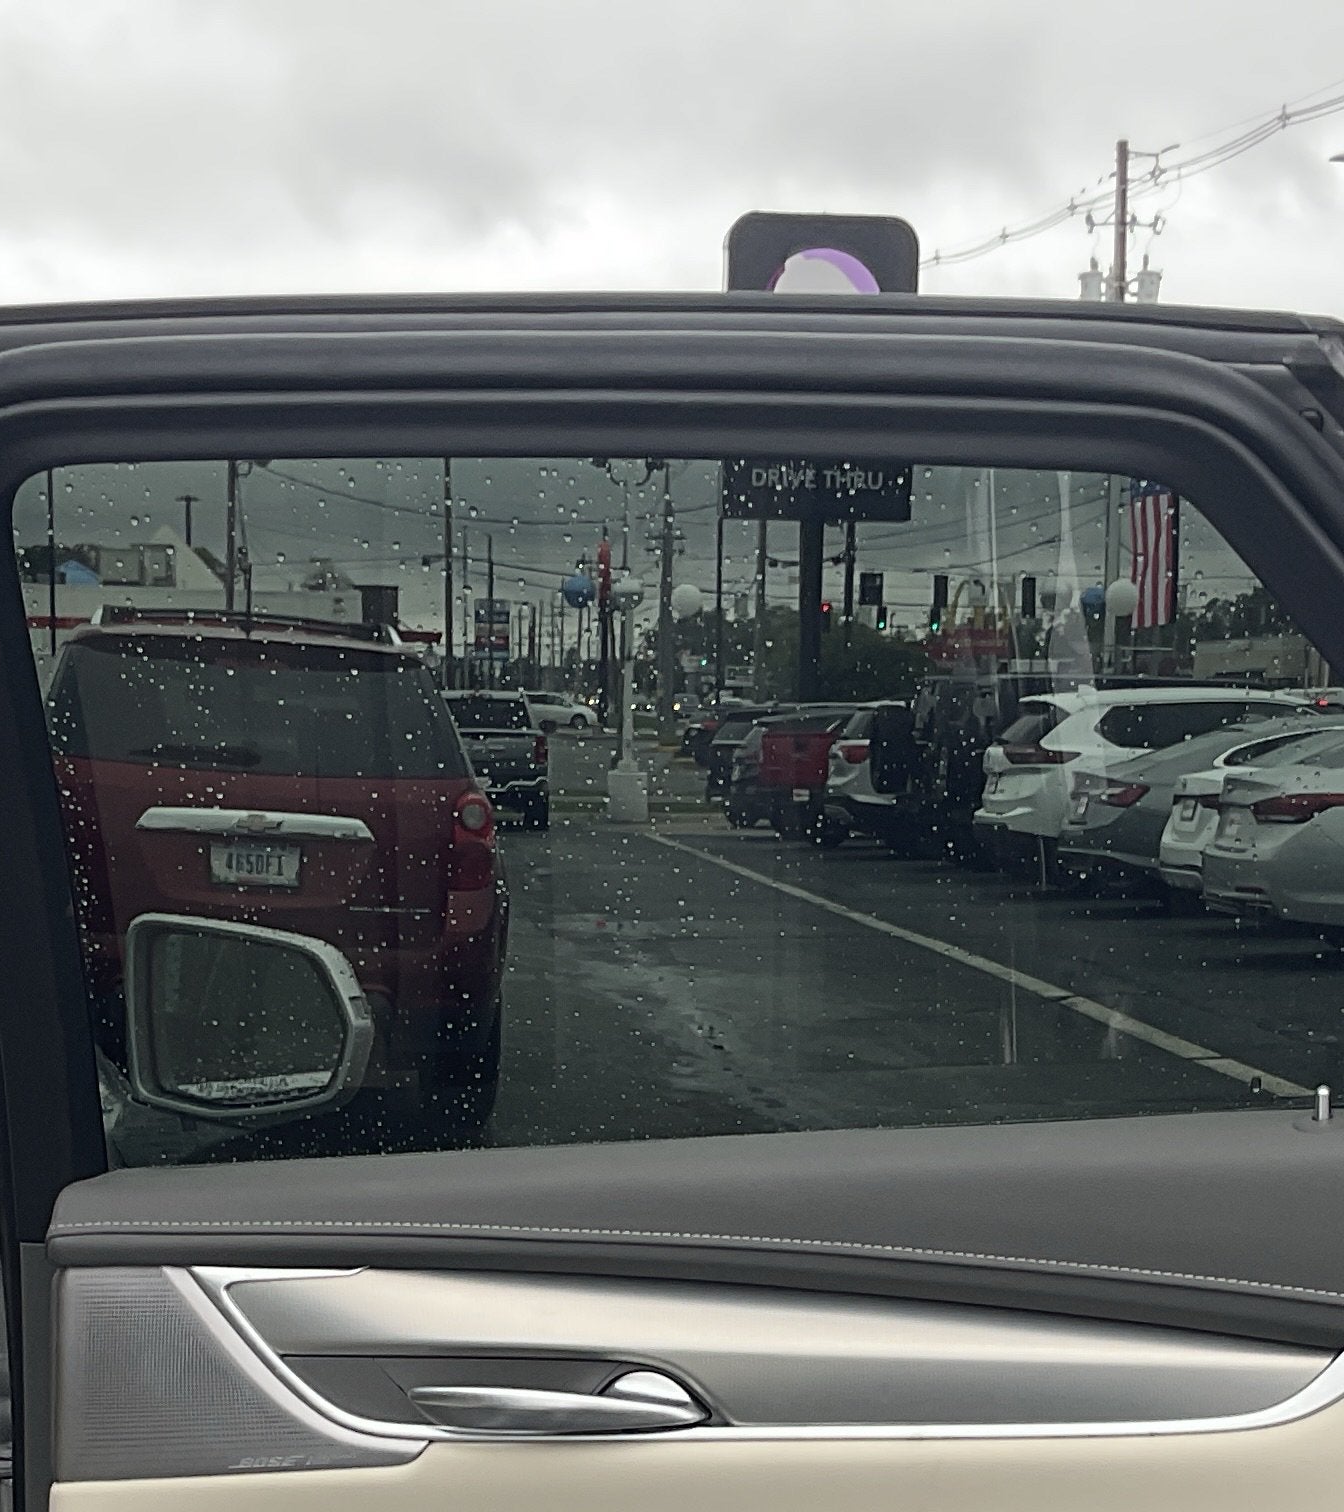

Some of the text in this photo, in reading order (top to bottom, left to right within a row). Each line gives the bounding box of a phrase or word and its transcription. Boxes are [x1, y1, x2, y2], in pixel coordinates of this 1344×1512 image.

[751, 467, 884, 490] DRIVE THRU
[229, 1455, 305, 1469] BOSE
